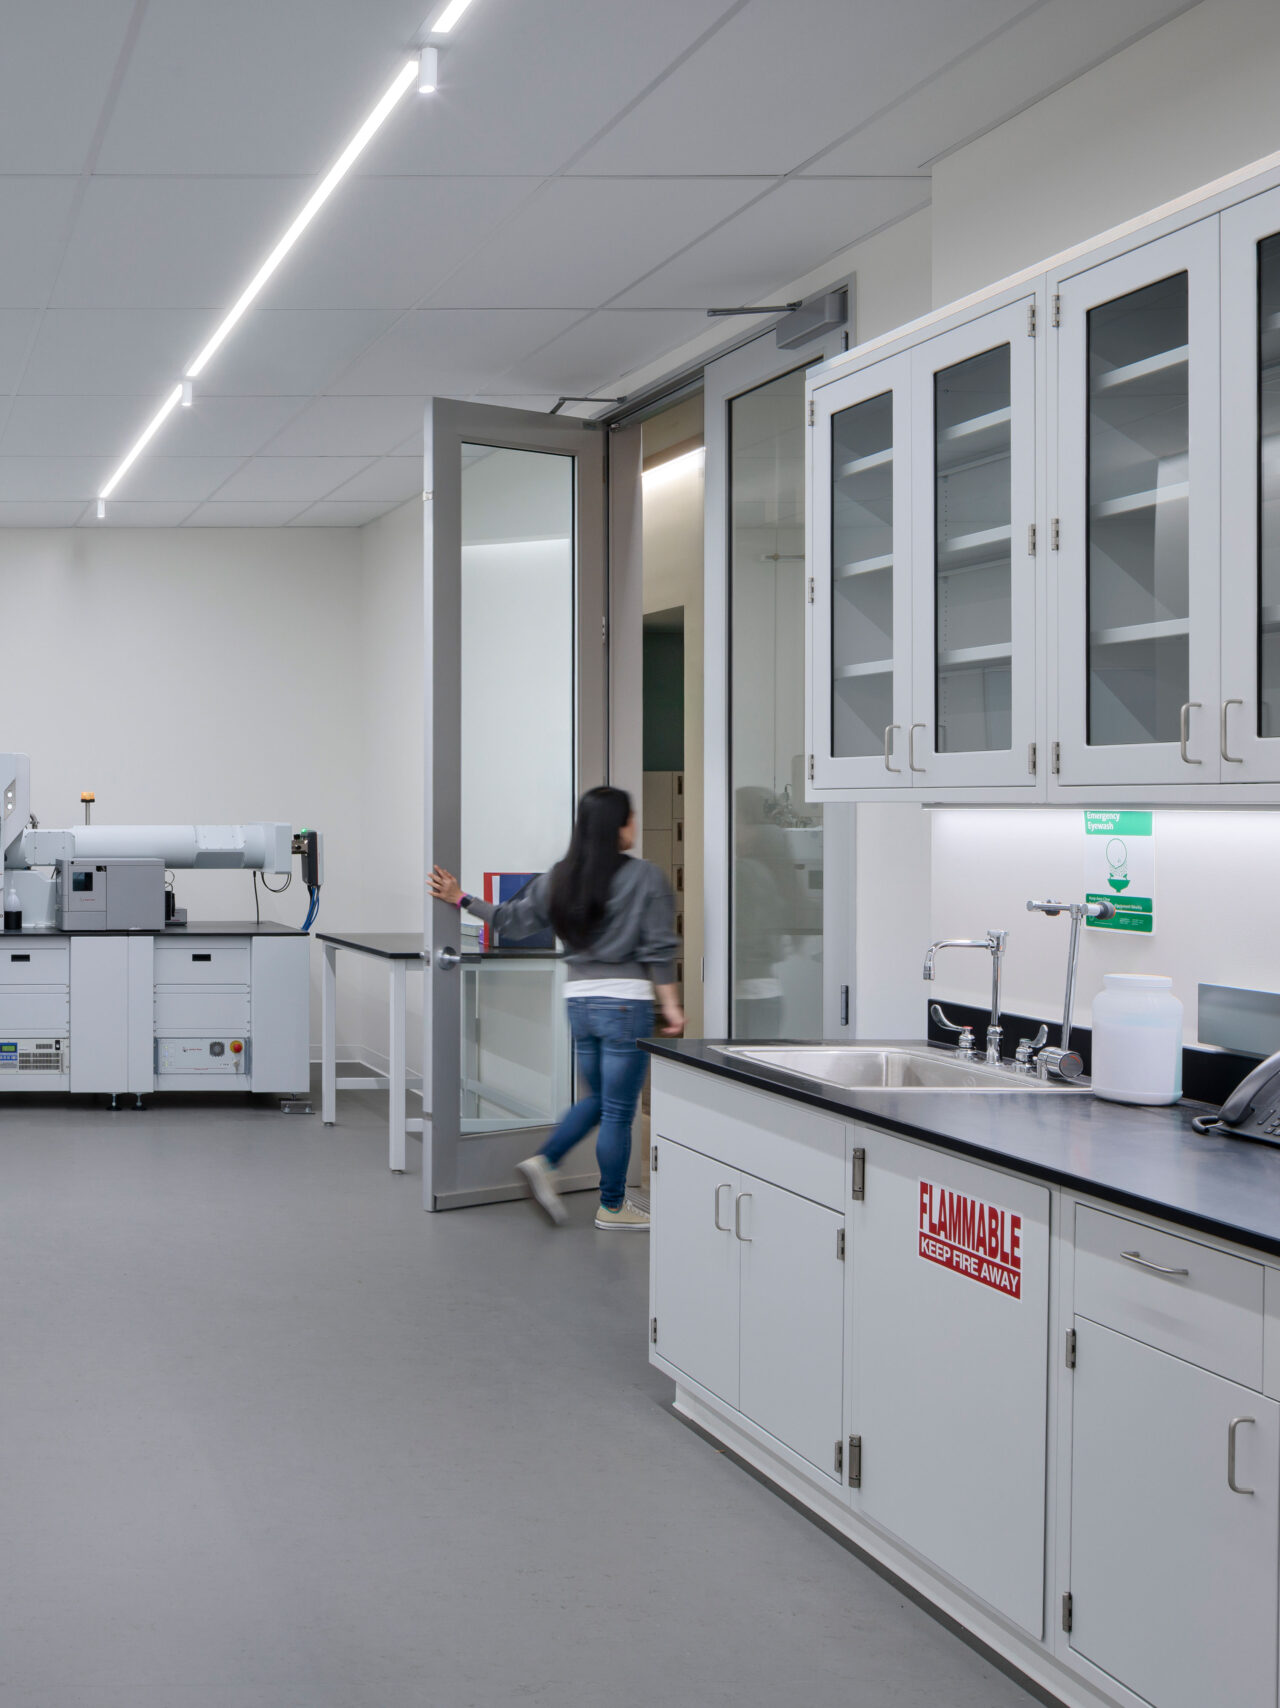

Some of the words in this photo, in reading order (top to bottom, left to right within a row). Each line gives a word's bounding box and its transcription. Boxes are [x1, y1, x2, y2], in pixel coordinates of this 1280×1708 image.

[1086, 811, 1120, 823] Emergency
[1087, 821, 1114, 832] Eyewash
[920, 1181, 1021, 1270] FLAMMABLE
[921, 1236, 951, 1262] KEEP
[953, 1249, 979, 1276] FIRE
[980, 1262, 1019, 1293] AWAY
